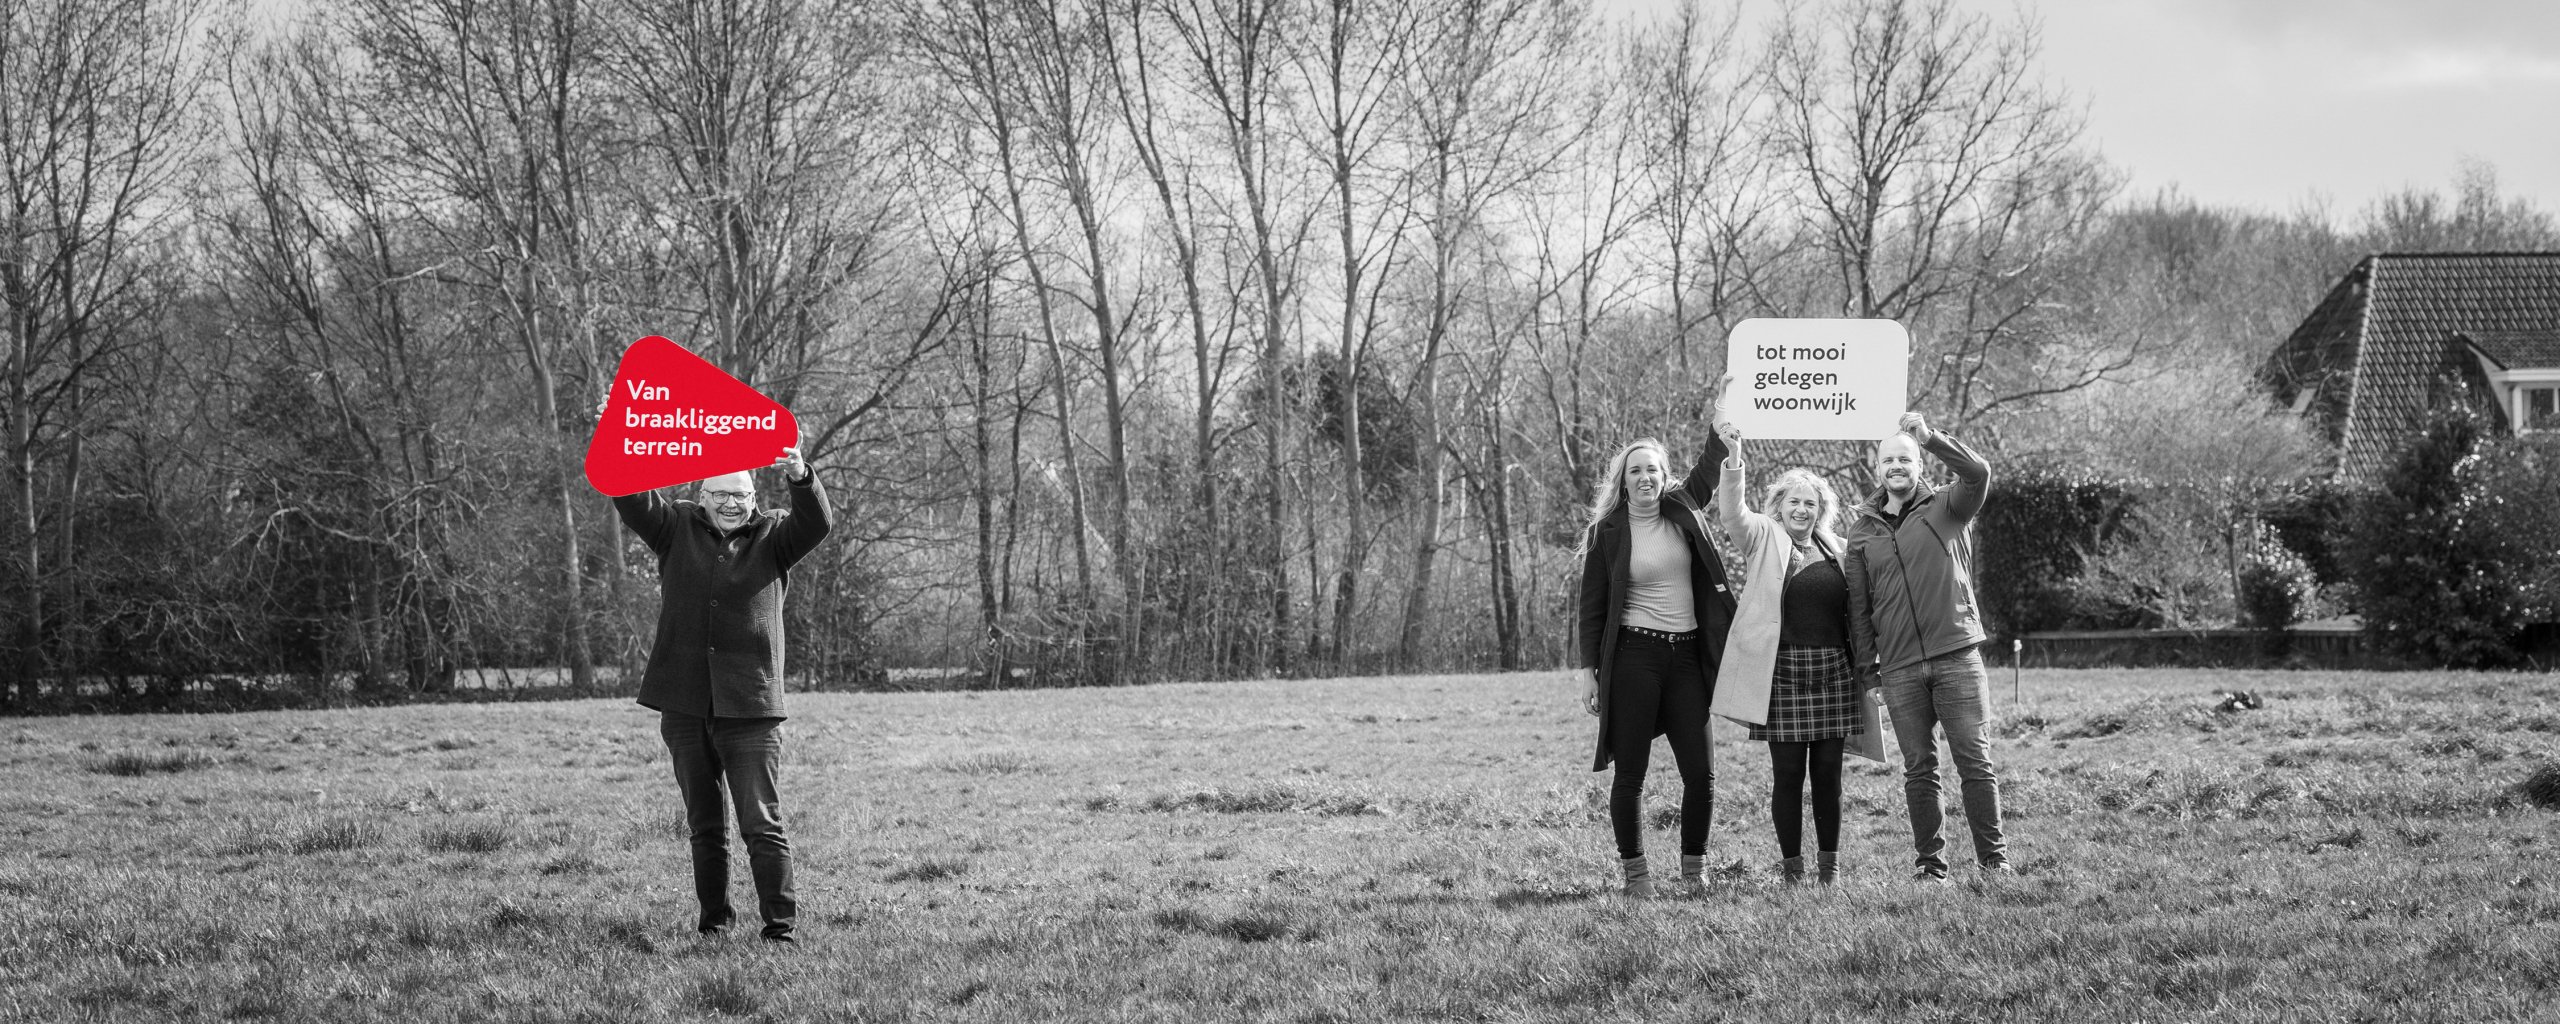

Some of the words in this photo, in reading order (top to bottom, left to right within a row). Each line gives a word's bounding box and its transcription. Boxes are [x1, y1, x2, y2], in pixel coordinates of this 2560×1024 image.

[1757, 345, 1786, 359] tot
[1793, 343, 1845, 360] mooi
[1755, 367, 1837, 390] gelegen
[627, 380, 669, 400] Van
[1754, 393, 1856, 415] woonwijk
[626, 407, 776, 434] braakliggend
[624, 436, 702, 456] terrein
